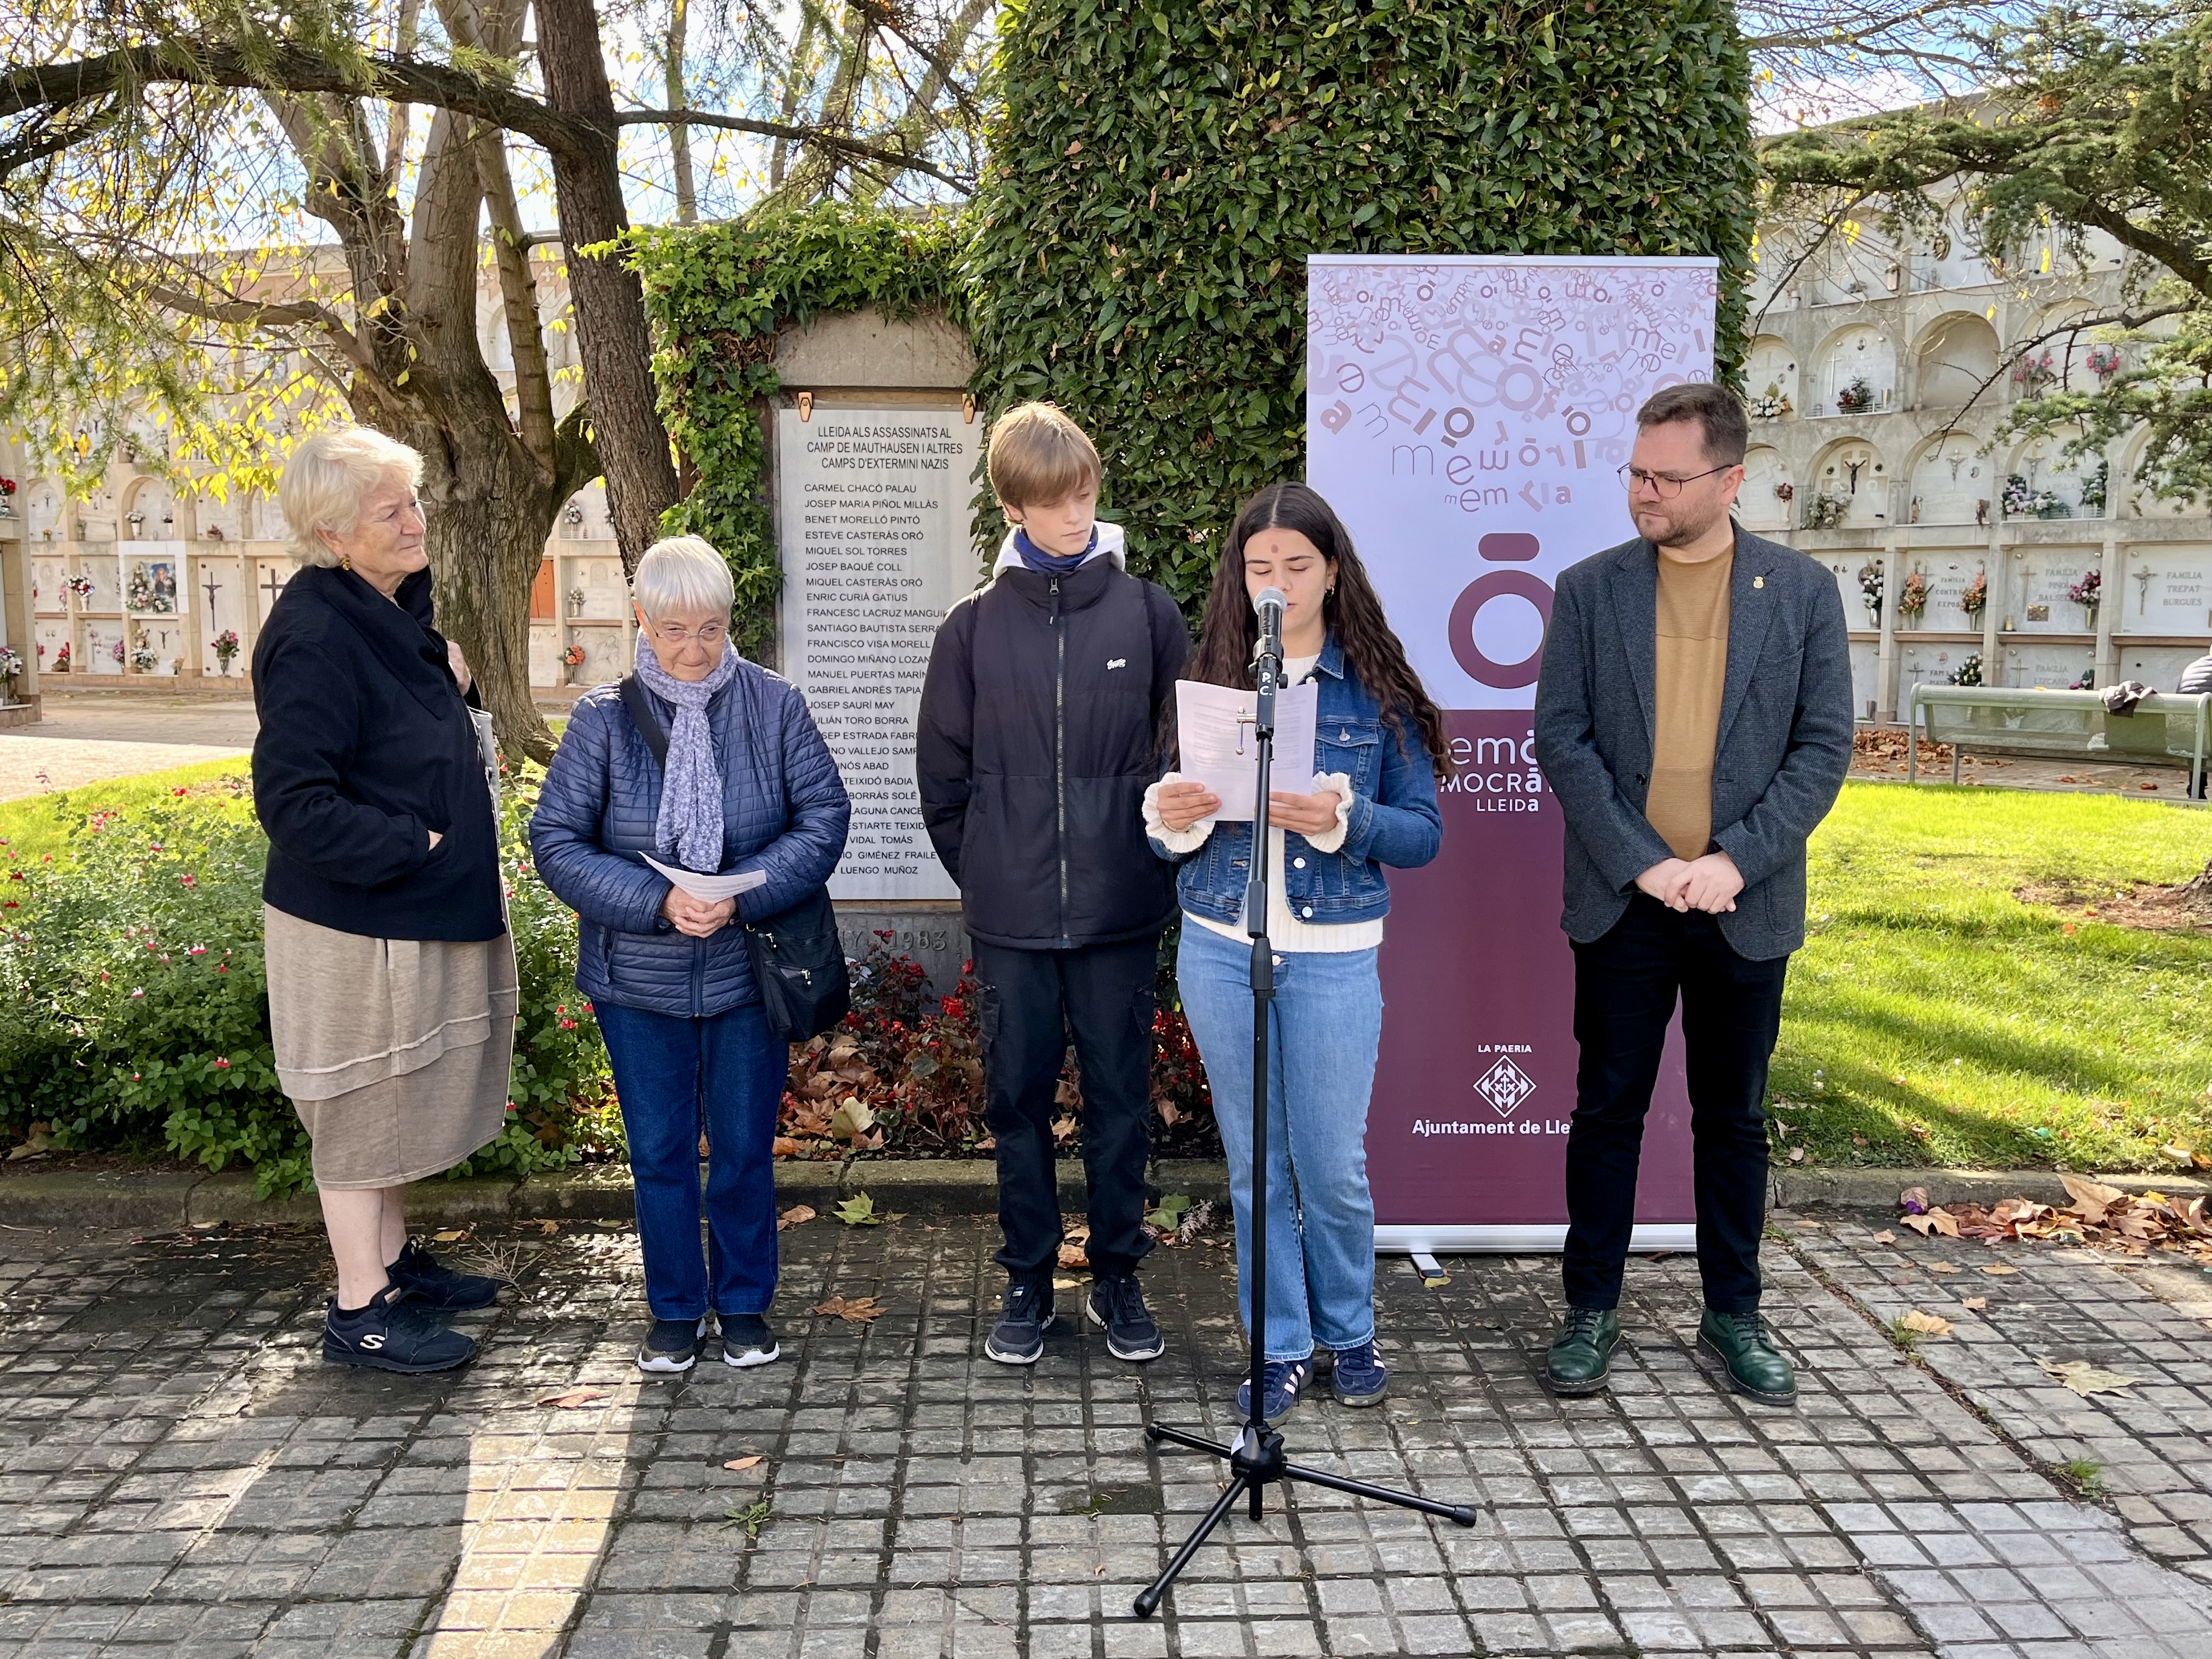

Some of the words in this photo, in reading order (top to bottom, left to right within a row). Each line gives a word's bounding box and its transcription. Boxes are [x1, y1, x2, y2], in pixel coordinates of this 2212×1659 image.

[819, 427, 850, 437] LLEIDA
[852, 427, 870, 437] ALS
[873, 427, 938, 438] ASSASSINATS
[940, 428, 951, 438] AL
[808, 442, 834, 452] CAMP
[838, 443, 850, 453] DE
[854, 443, 919, 453] MAUTHAUSEN
[922, 443, 924, 453] I
[927, 443, 962, 454] ALTRES
[822, 458, 855, 468] CAMPS
[859, 459, 917, 469] D'EXTERMINI
[921, 459, 948, 469] NAZIS
[848, 483, 882, 492] CHACÓ
[873, 499, 901, 508] PIÑOL
[904, 499, 938, 509] MILLÀS
[840, 515, 887, 524] MORELLÓ
[891, 515, 919, 524] PINTÓ
[847, 531, 899, 539] CASTERÀS
[902, 531, 923, 540] ORÓ
[840, 562, 873, 571] BAQUÉ
[846, 578, 898, 586] CASTERÀS
[901, 578, 922, 586] ORÓ
[840, 592, 870, 601] CURIÀ
[858, 654, 896, 663] MIÑANO
[843, 701, 871, 709] SAURÍ
[813, 715, 841, 724] ULIÁN
[844, 776, 882, 785] TEIXIDÓ
[881, 835, 912, 843] TOMÀS
[885, 866, 917, 874] MUÑOZ
[1478, 1045, 1491, 1053] LA
[1494, 1045, 1532, 1053] PAERIA
[1412, 1120, 1515, 1137] Ajuntament
[1519, 1120, 1541, 1135] de
[1545, 1120, 1573, 1135] Lle
